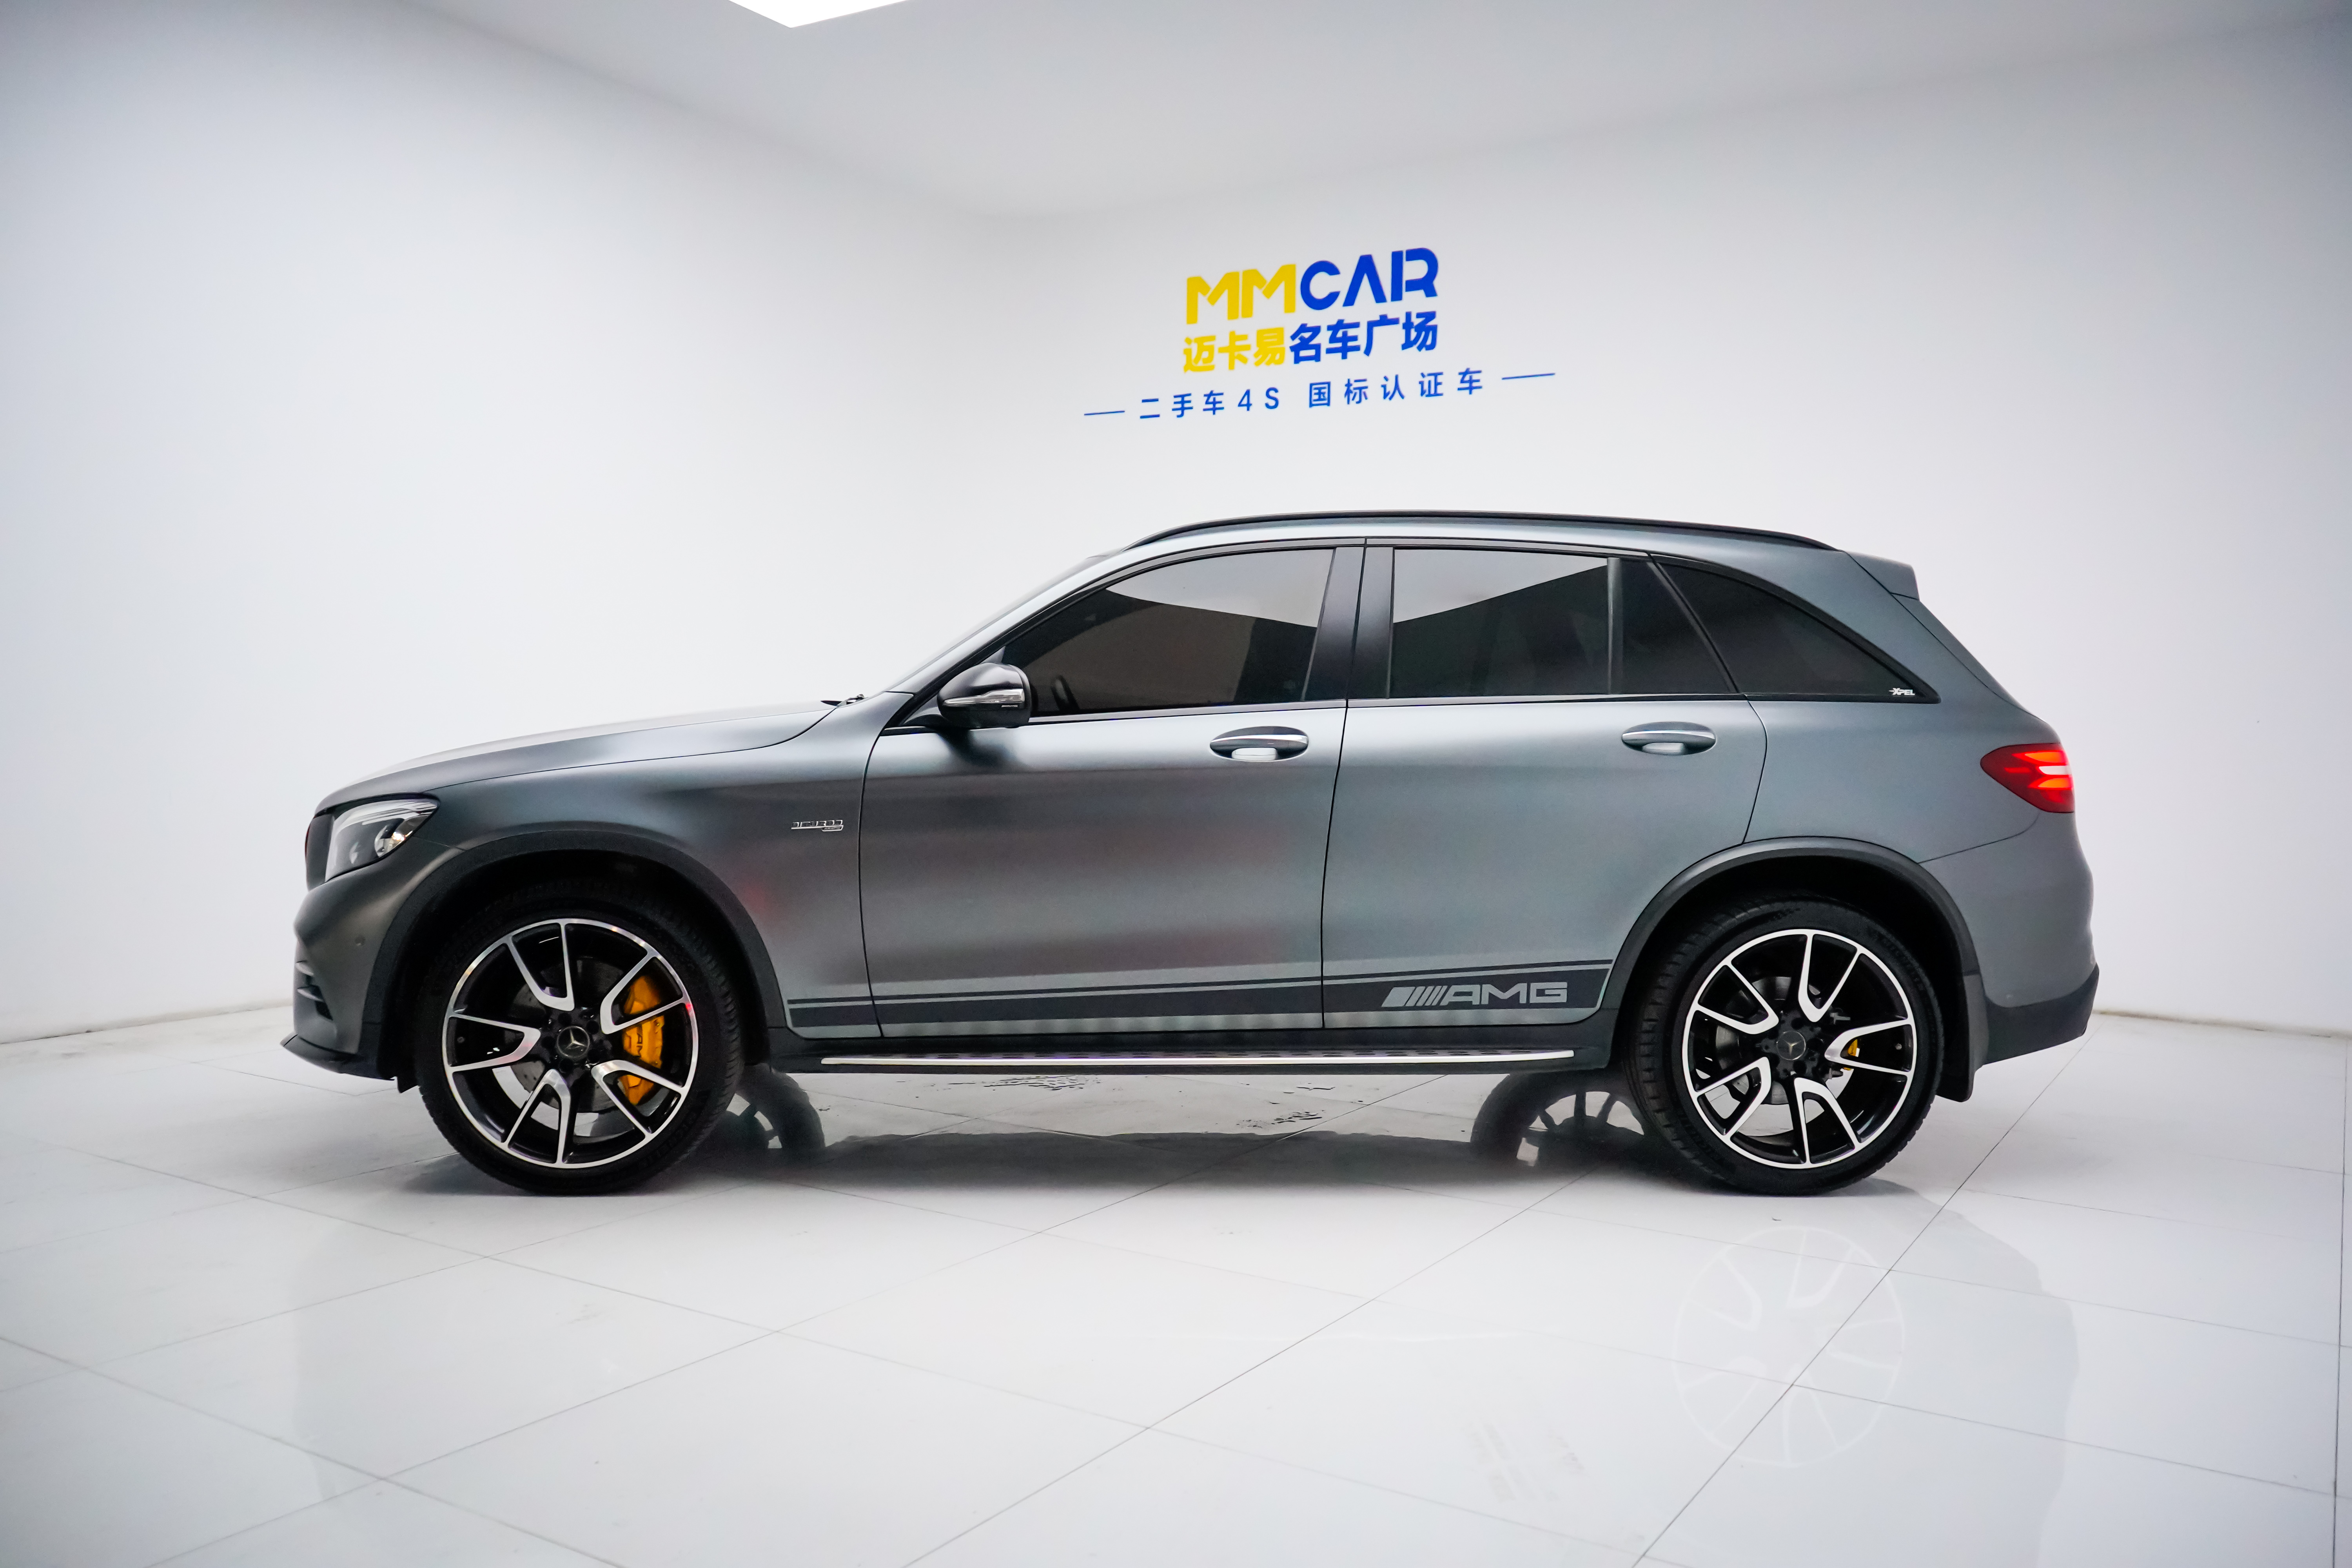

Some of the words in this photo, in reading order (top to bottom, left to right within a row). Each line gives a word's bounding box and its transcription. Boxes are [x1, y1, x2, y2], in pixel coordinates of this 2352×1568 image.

[1186, 247, 1439, 325] MMCAR
[1183, 311, 1438, 373] 迈卡易名车广场
[1308, 368, 1483, 408] 国标认证车
